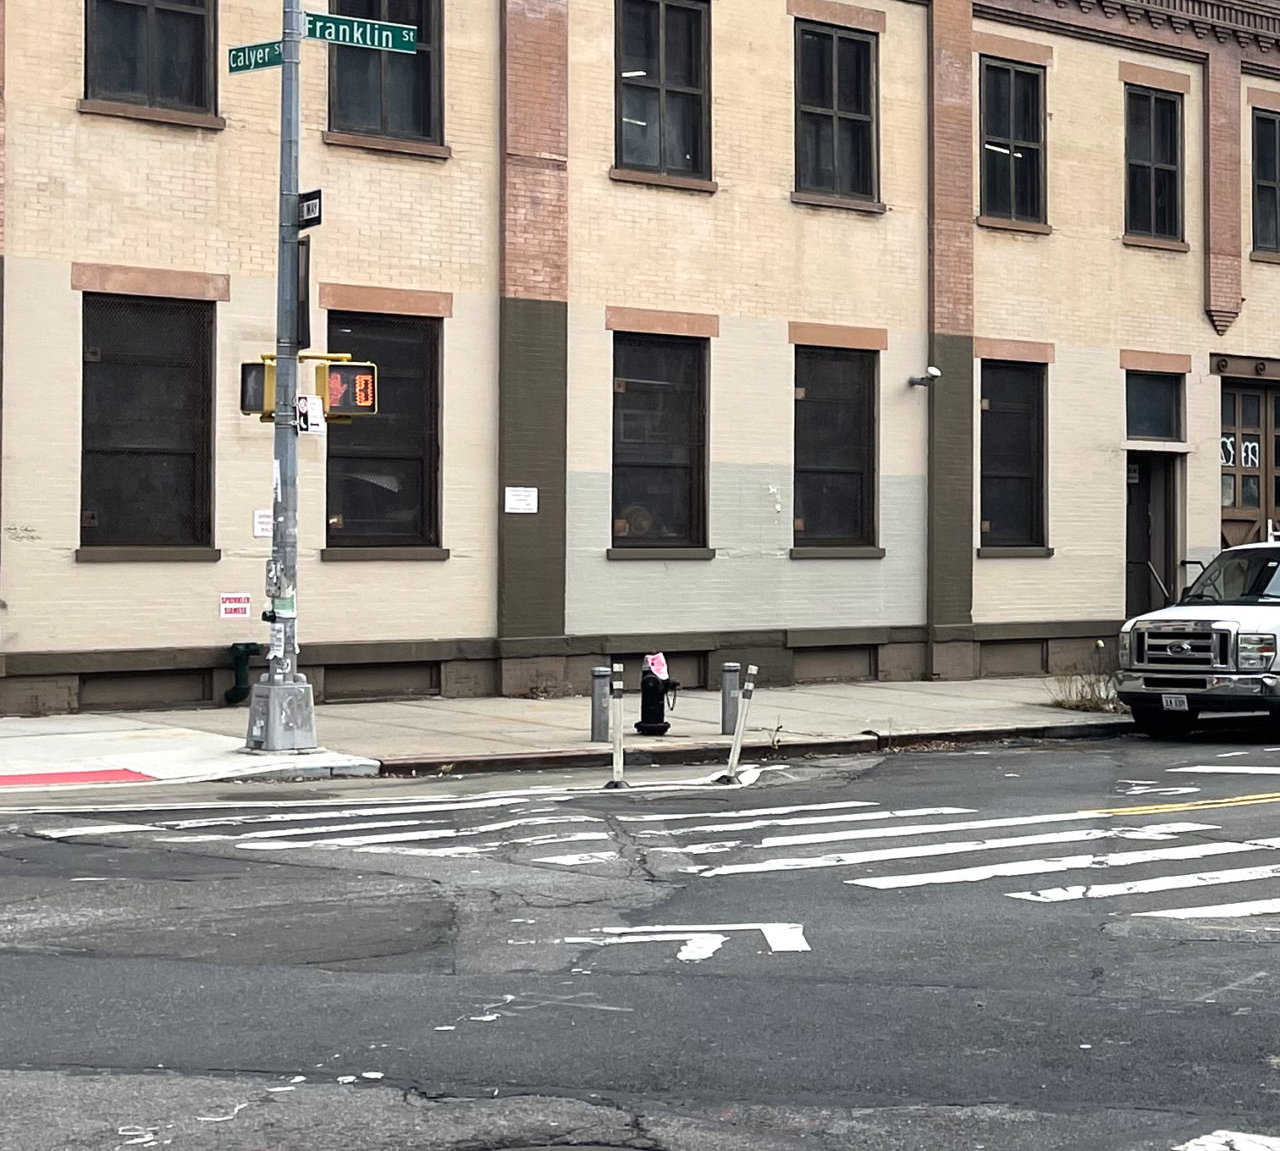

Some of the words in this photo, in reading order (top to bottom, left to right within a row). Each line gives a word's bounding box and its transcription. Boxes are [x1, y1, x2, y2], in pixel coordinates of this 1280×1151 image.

[306, 17, 393, 48] Franklin
[402, 30, 415, 42] St
[230, 47, 270, 69] Calyer
